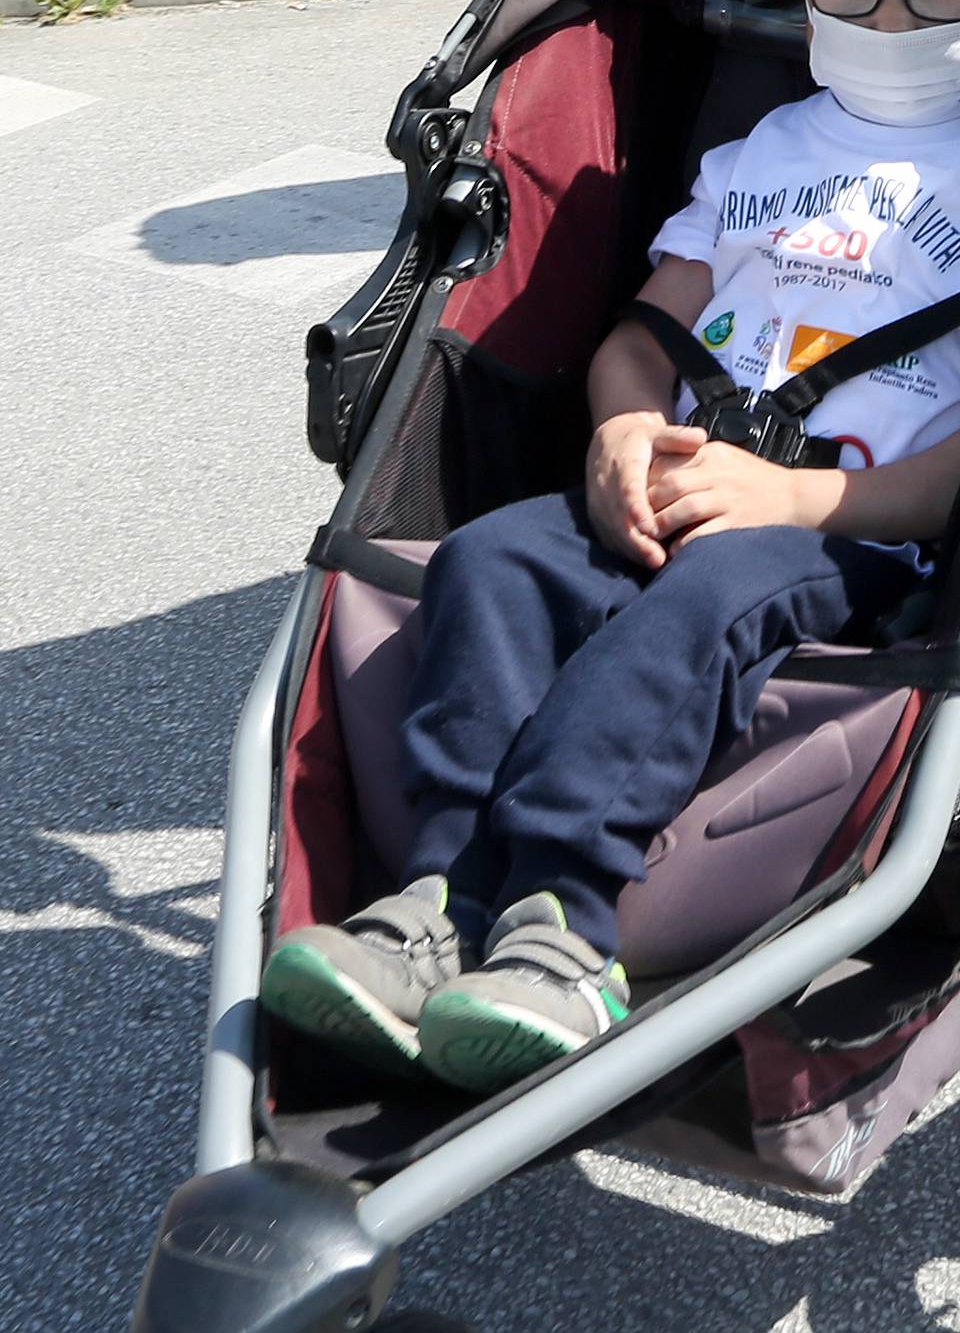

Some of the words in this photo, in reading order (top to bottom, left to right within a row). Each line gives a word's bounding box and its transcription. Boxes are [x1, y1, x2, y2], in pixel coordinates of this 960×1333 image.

[791, 174, 868, 219] INSIEME
[868, 176, 905, 221] PER
[895, 188, 936, 230] LA
[767, 226, 868, 262] +500
[787, 259, 824, 273] rene
[774, 274, 847, 293] 1987-2017
[868, 371, 906, 390] Infantile
